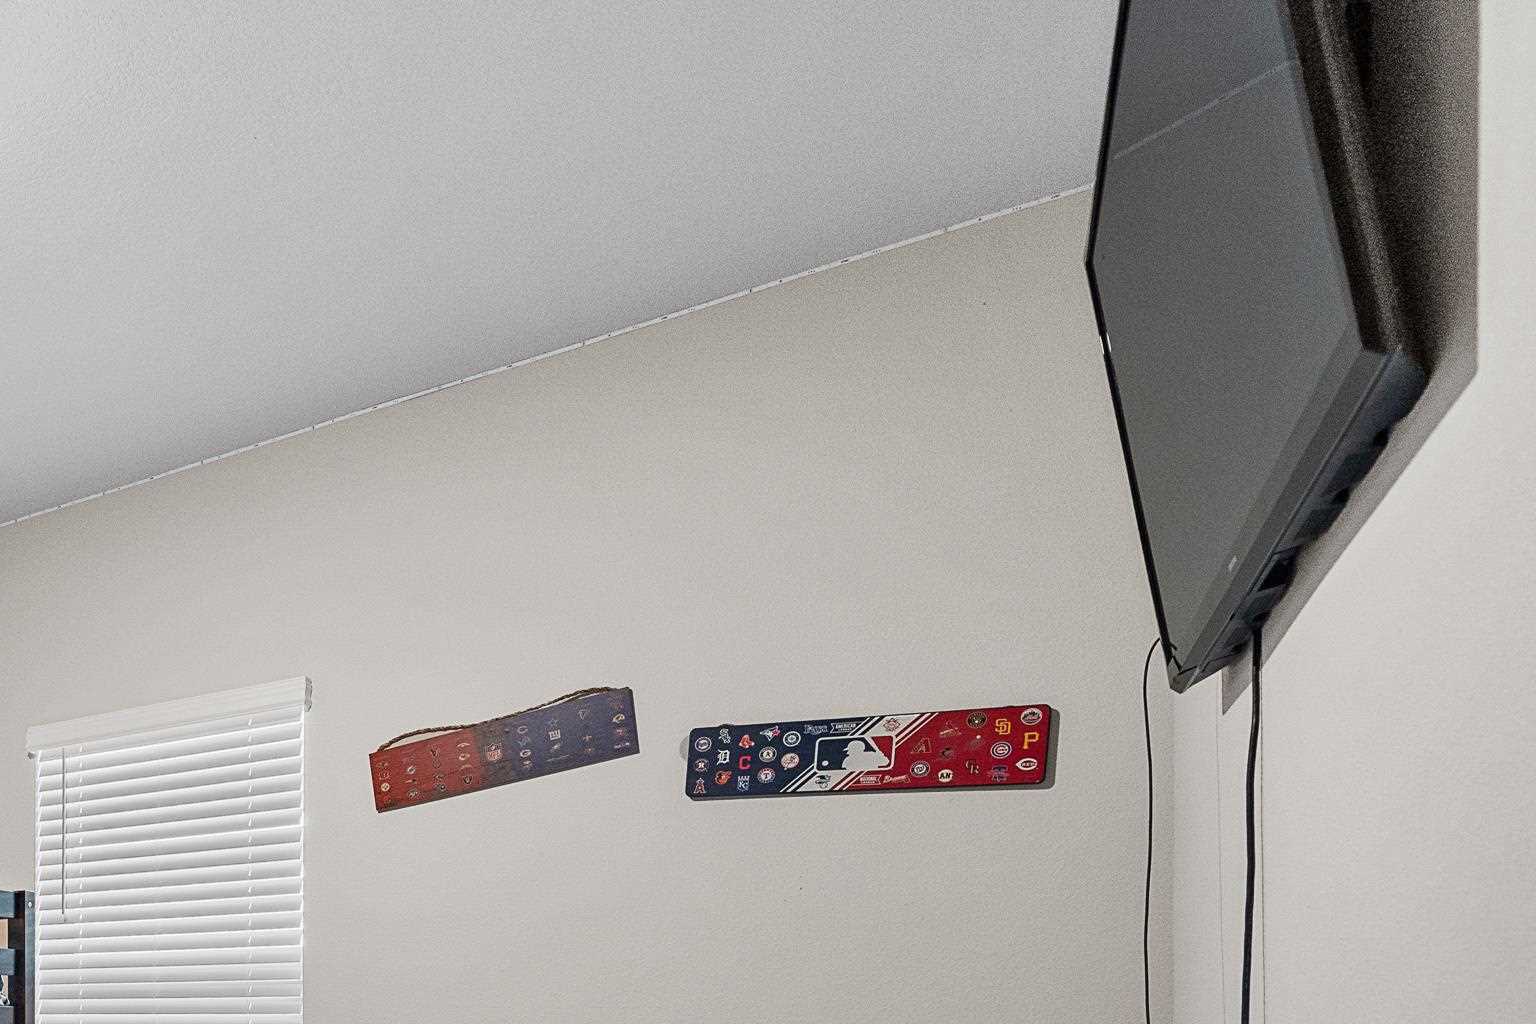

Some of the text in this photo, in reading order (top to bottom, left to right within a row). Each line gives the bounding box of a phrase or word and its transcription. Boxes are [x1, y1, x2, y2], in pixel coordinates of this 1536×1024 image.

[995, 718, 1011, 735] SD
[1022, 732, 1040, 749] P
[716, 749, 730, 765] D
[738, 755, 752, 770] C
